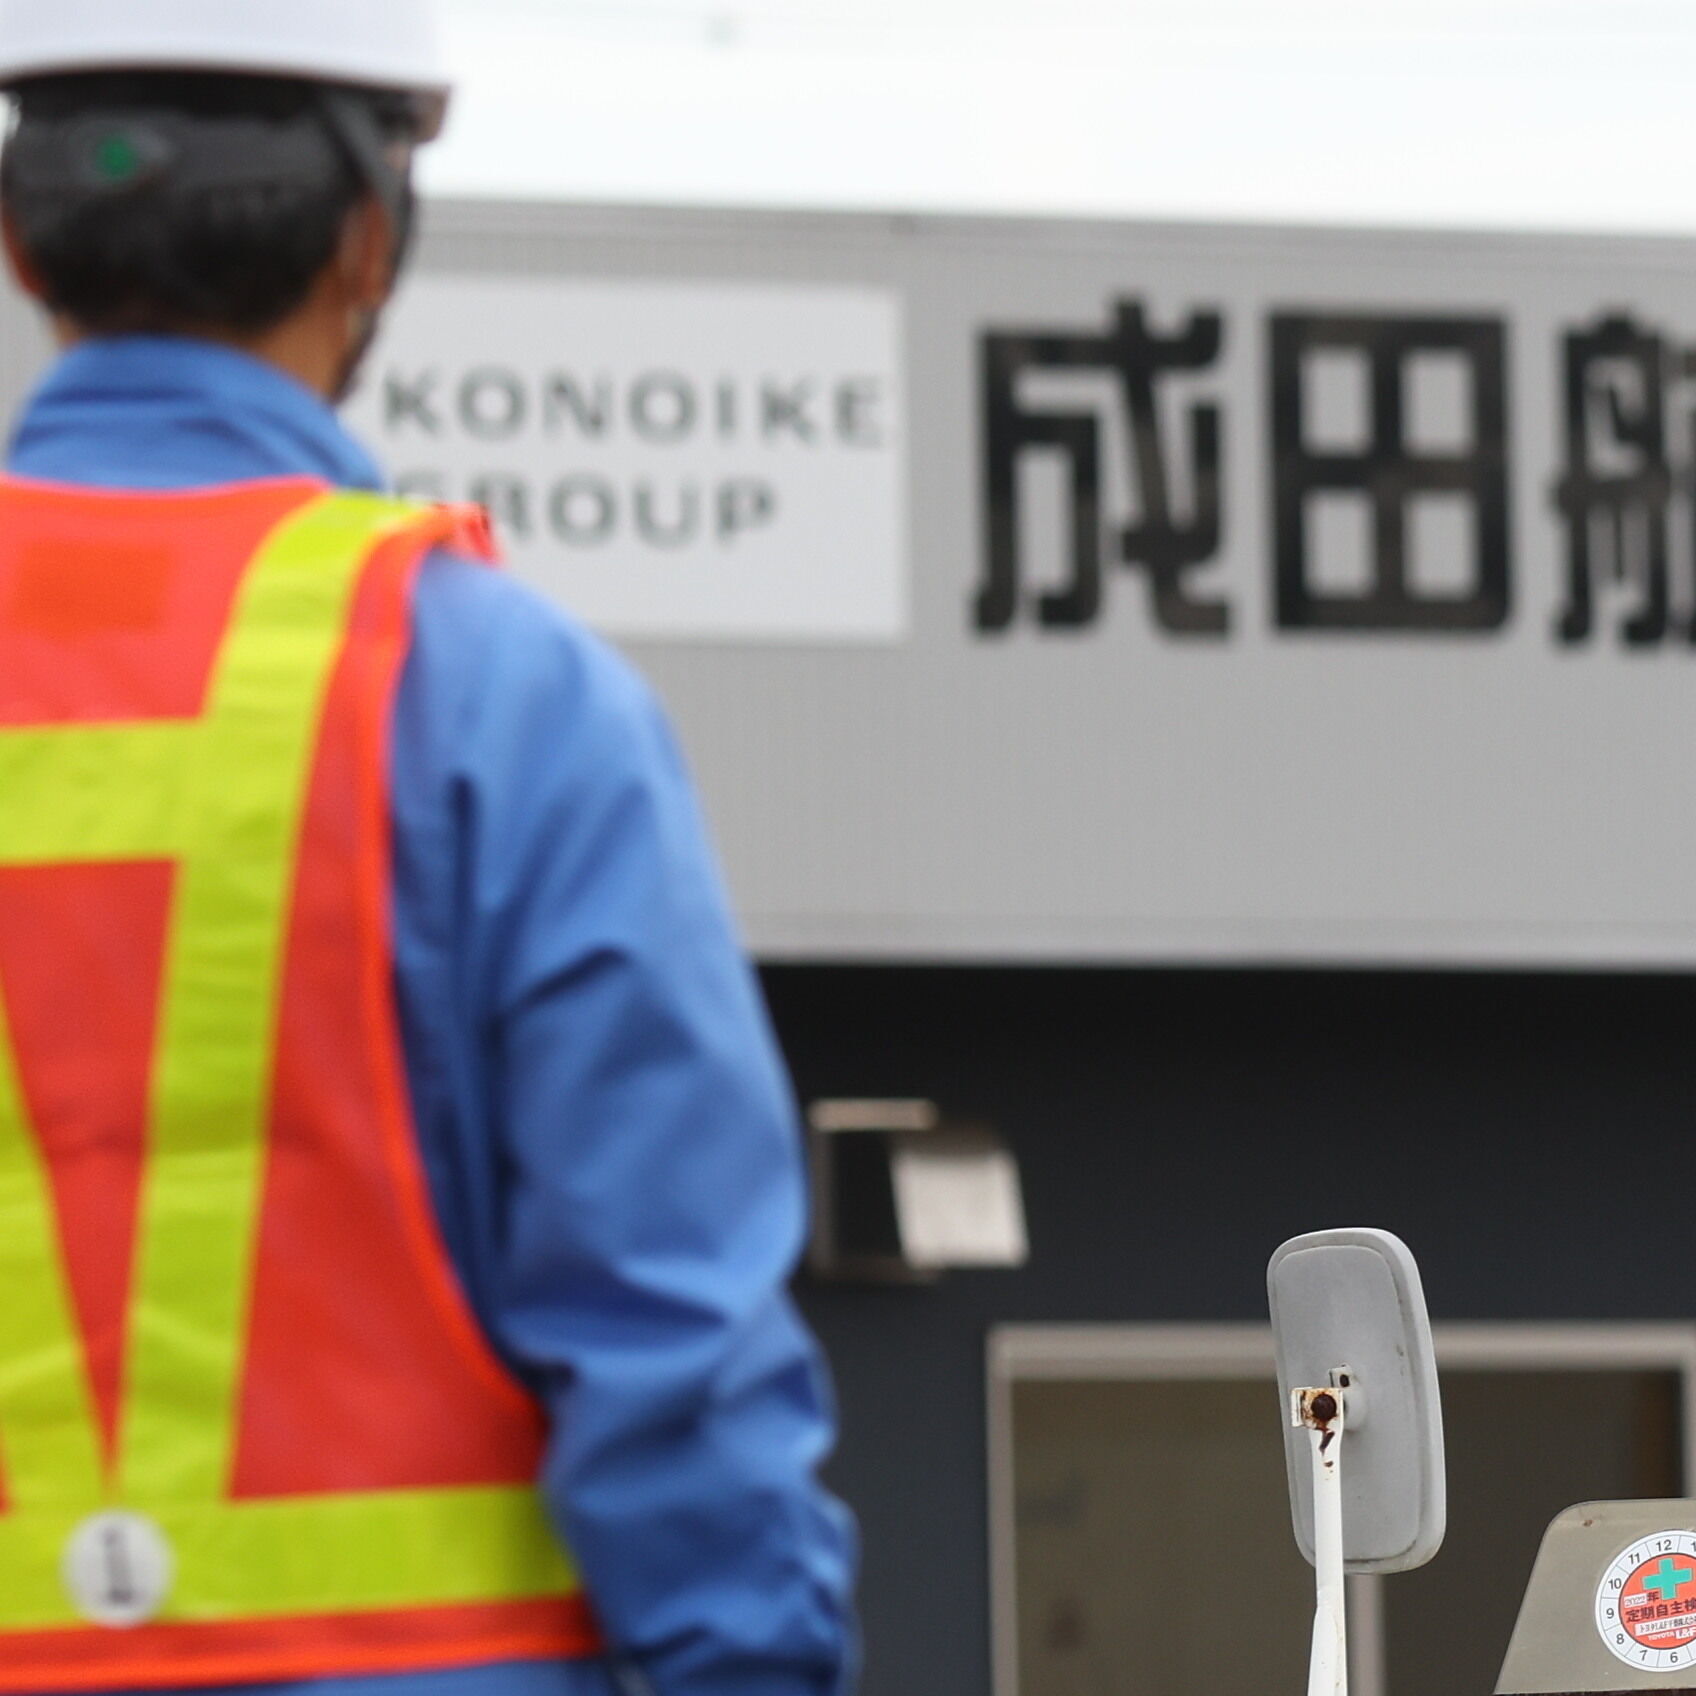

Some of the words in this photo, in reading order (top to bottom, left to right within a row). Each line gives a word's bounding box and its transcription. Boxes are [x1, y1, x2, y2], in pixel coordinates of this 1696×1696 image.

[384, 366, 883, 449] KONOIKE
[1655, 1539, 1673, 1552] 12
[1691, 1541, 1696, 1552] 1
[1628, 1553, 1641, 1565] 11
[1608, 1578, 1622, 1590] 10
[1606, 1608, 1615, 1619] 9
[1616, 1633, 1625, 1644] 8
[1640, 1650, 1648, 1661] 7
[1670, 1652, 1678, 1663] 6
